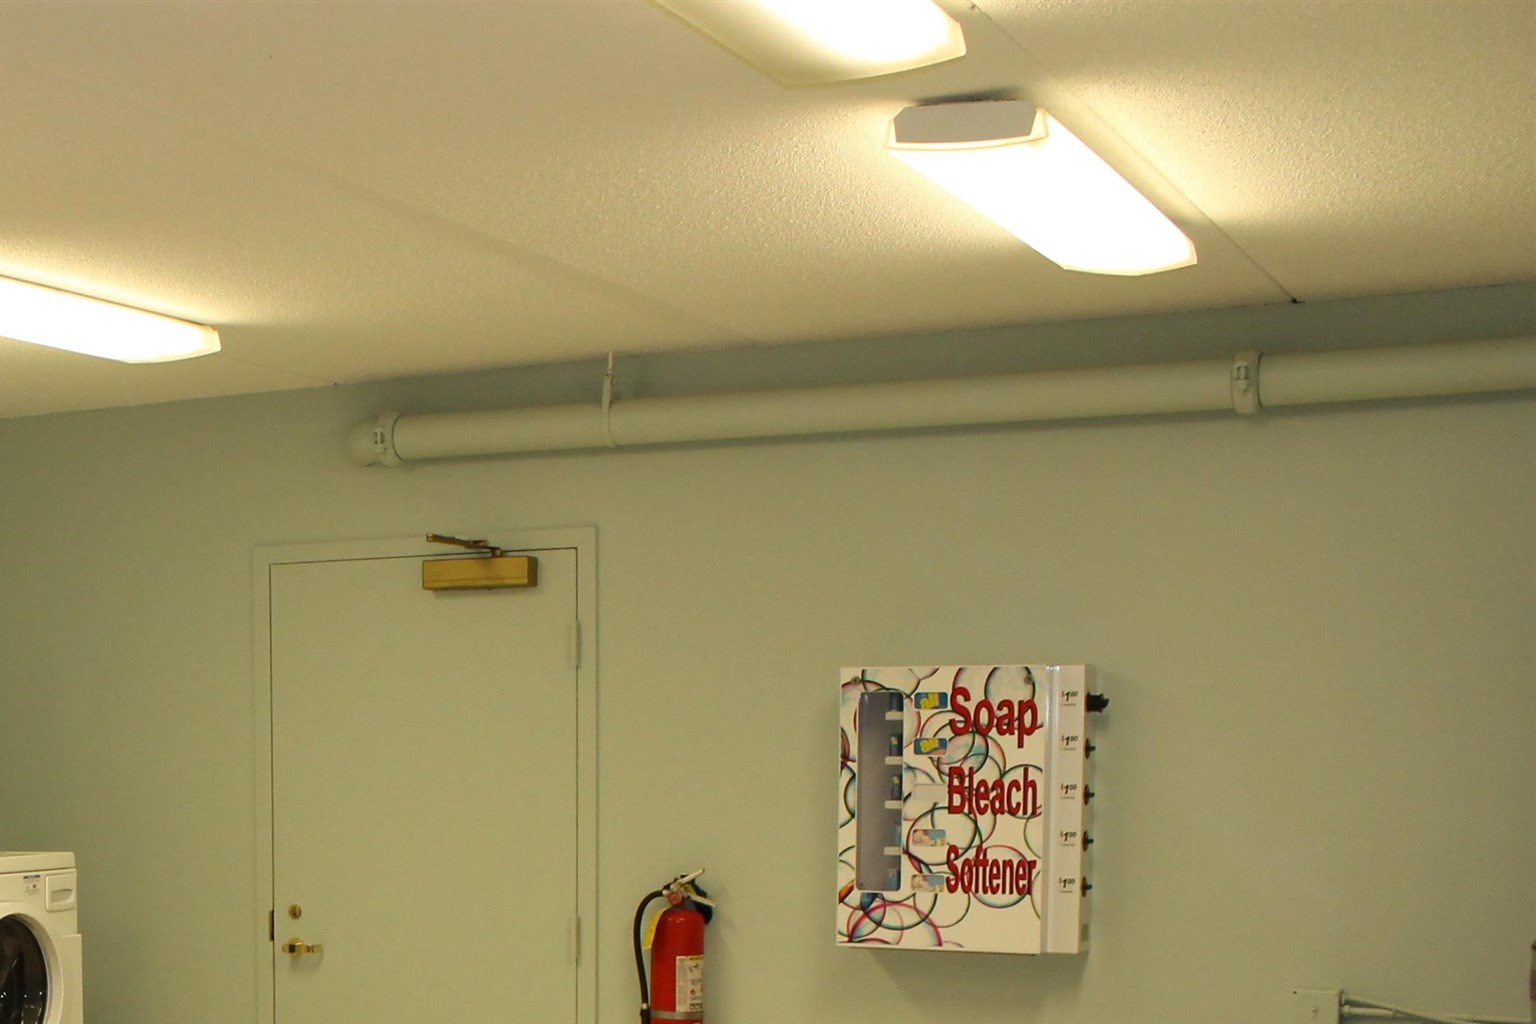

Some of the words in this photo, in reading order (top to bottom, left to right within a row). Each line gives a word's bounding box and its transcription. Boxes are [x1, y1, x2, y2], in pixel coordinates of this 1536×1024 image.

[948, 686, 1039, 749] Soap
[947, 766, 1038, 816] Bleach
[946, 844, 1037, 896] Softener
